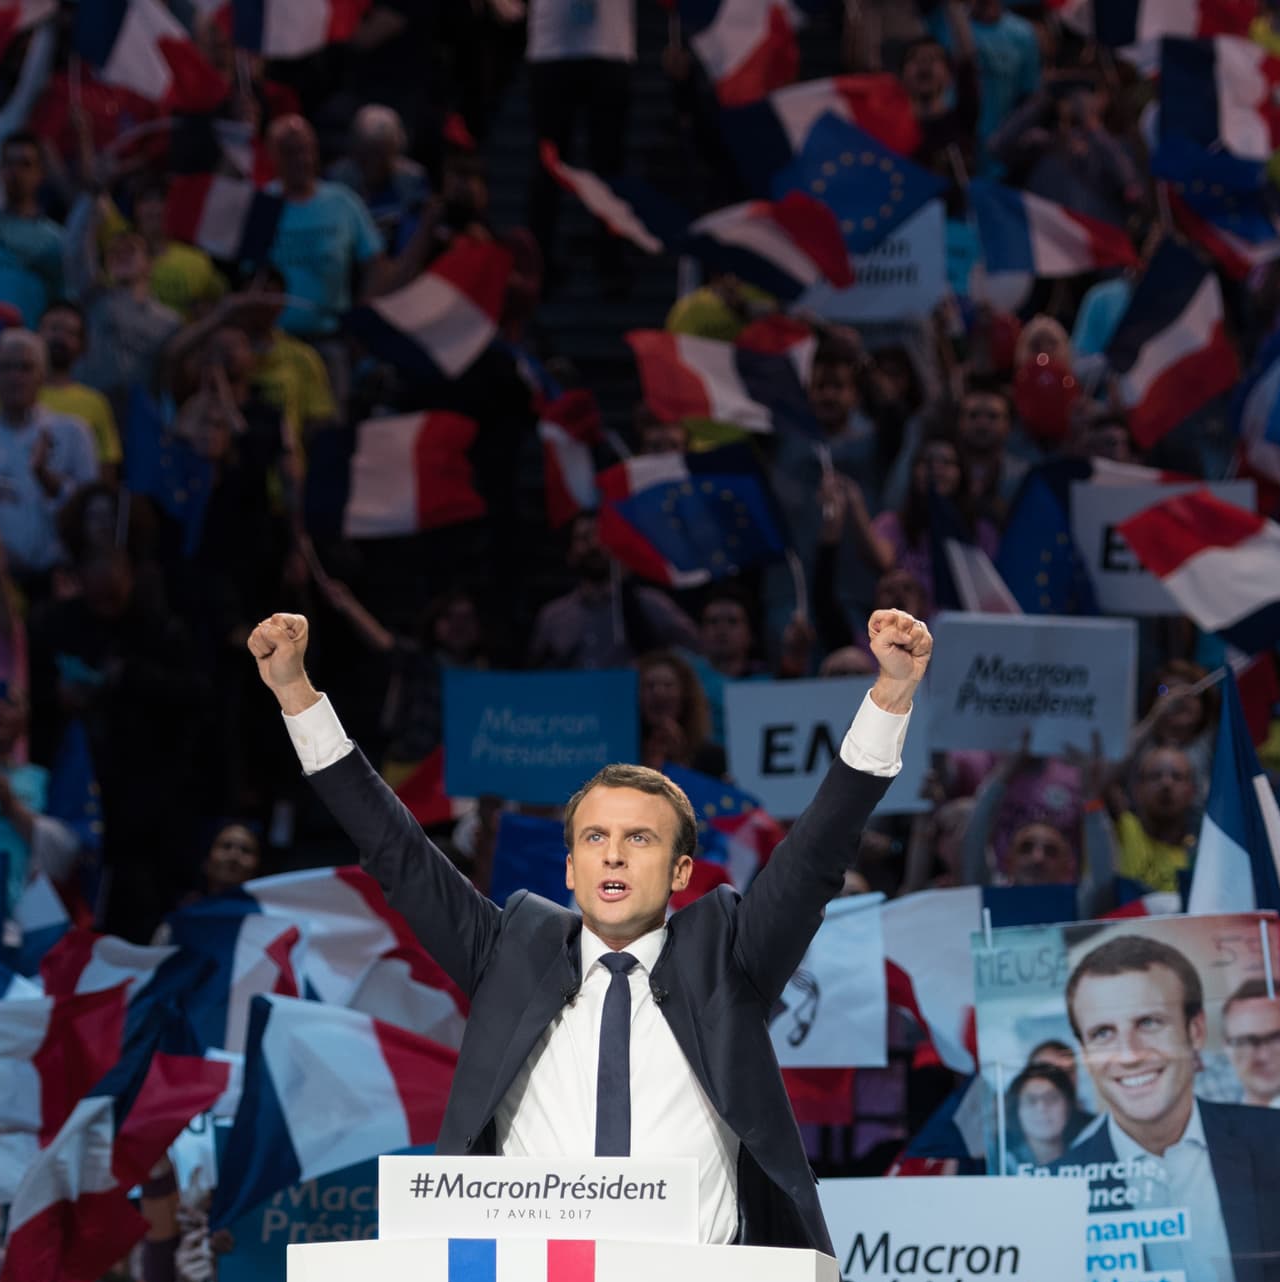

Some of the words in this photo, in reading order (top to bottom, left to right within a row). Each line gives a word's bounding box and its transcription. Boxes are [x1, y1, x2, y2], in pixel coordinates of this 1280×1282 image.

[969, 655, 1090, 686] Macron
[478, 706, 600, 738] Macron
[409, 1173, 667, 1200] #MacronPrésident
[486, 1208, 500, 1219] 17
[508, 1209, 551, 1220] AVRIL
[560, 1209, 592, 1219] 2017
[844, 1231, 1020, 1275] Macron
